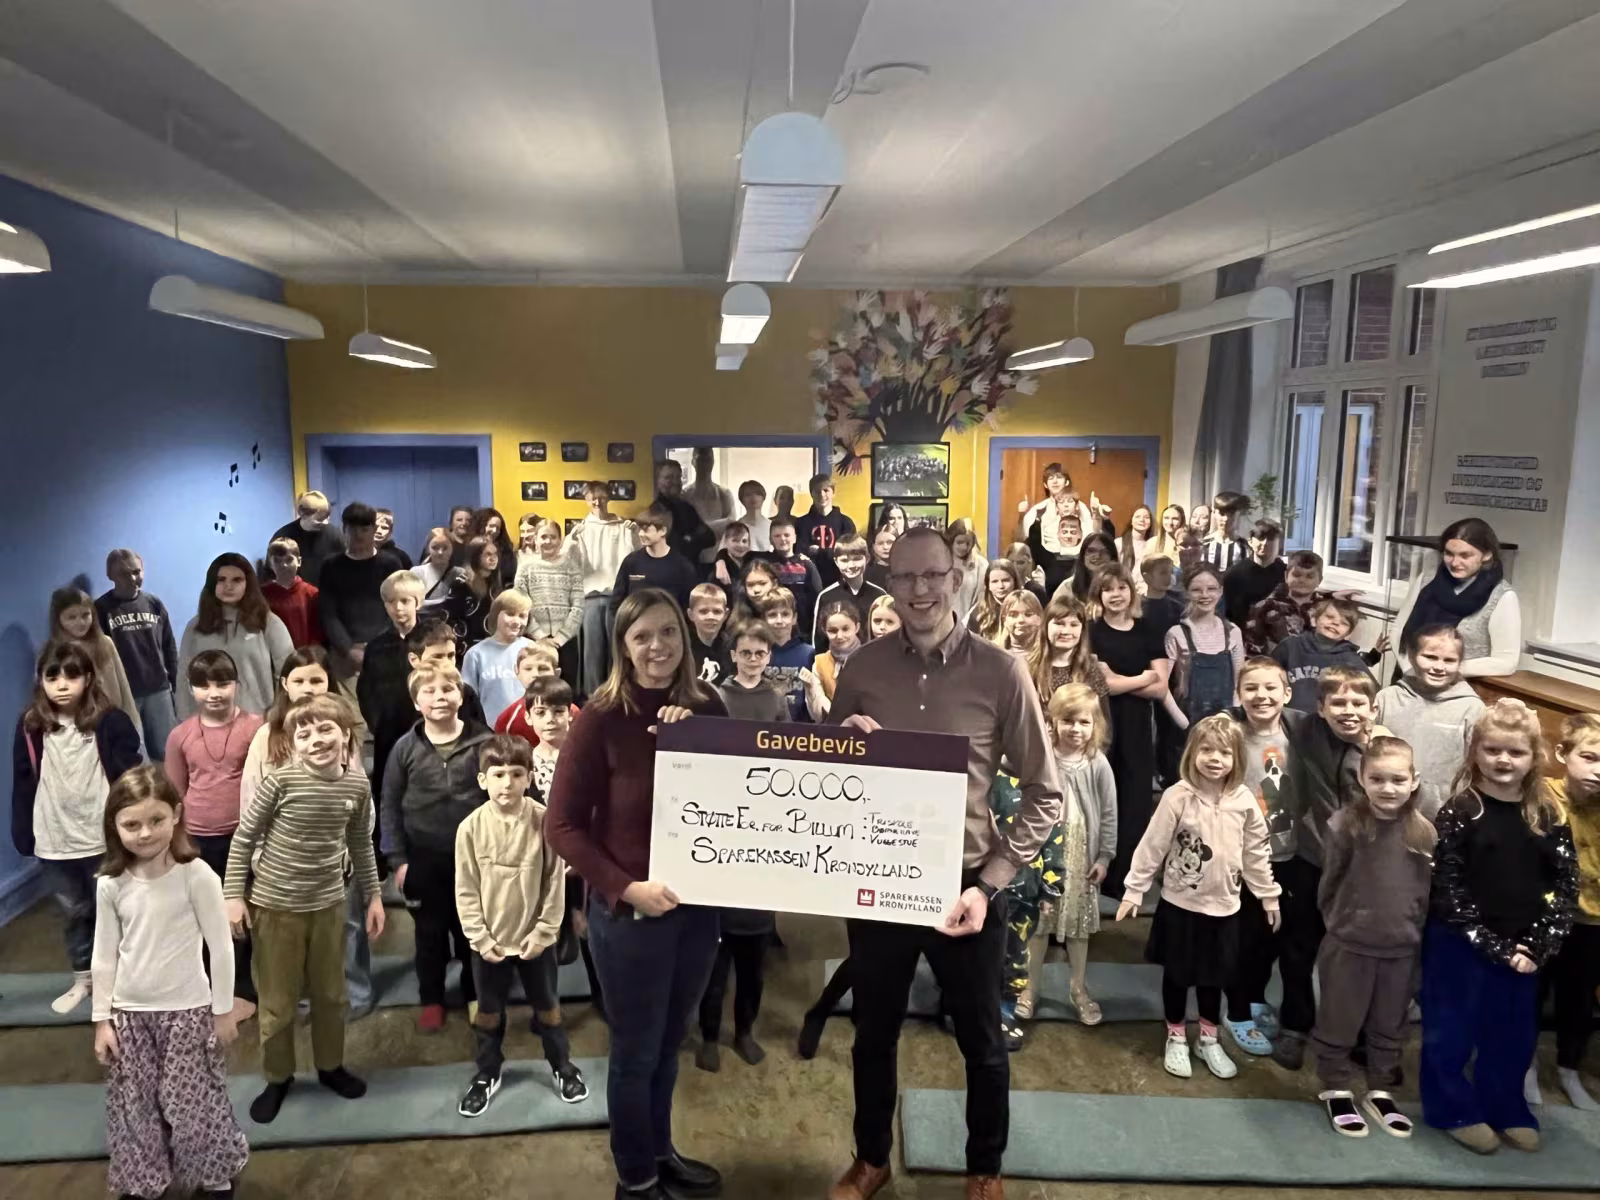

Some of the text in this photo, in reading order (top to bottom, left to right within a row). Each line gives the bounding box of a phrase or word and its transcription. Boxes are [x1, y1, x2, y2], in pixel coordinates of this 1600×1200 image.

[756, 730, 866, 756] Gavebevis
[691, 836, 810, 868] SPAREKASSEN
[879, 900, 942, 913] KRONJYLLAND
[880, 891, 942, 904] SPAREKASSEN
